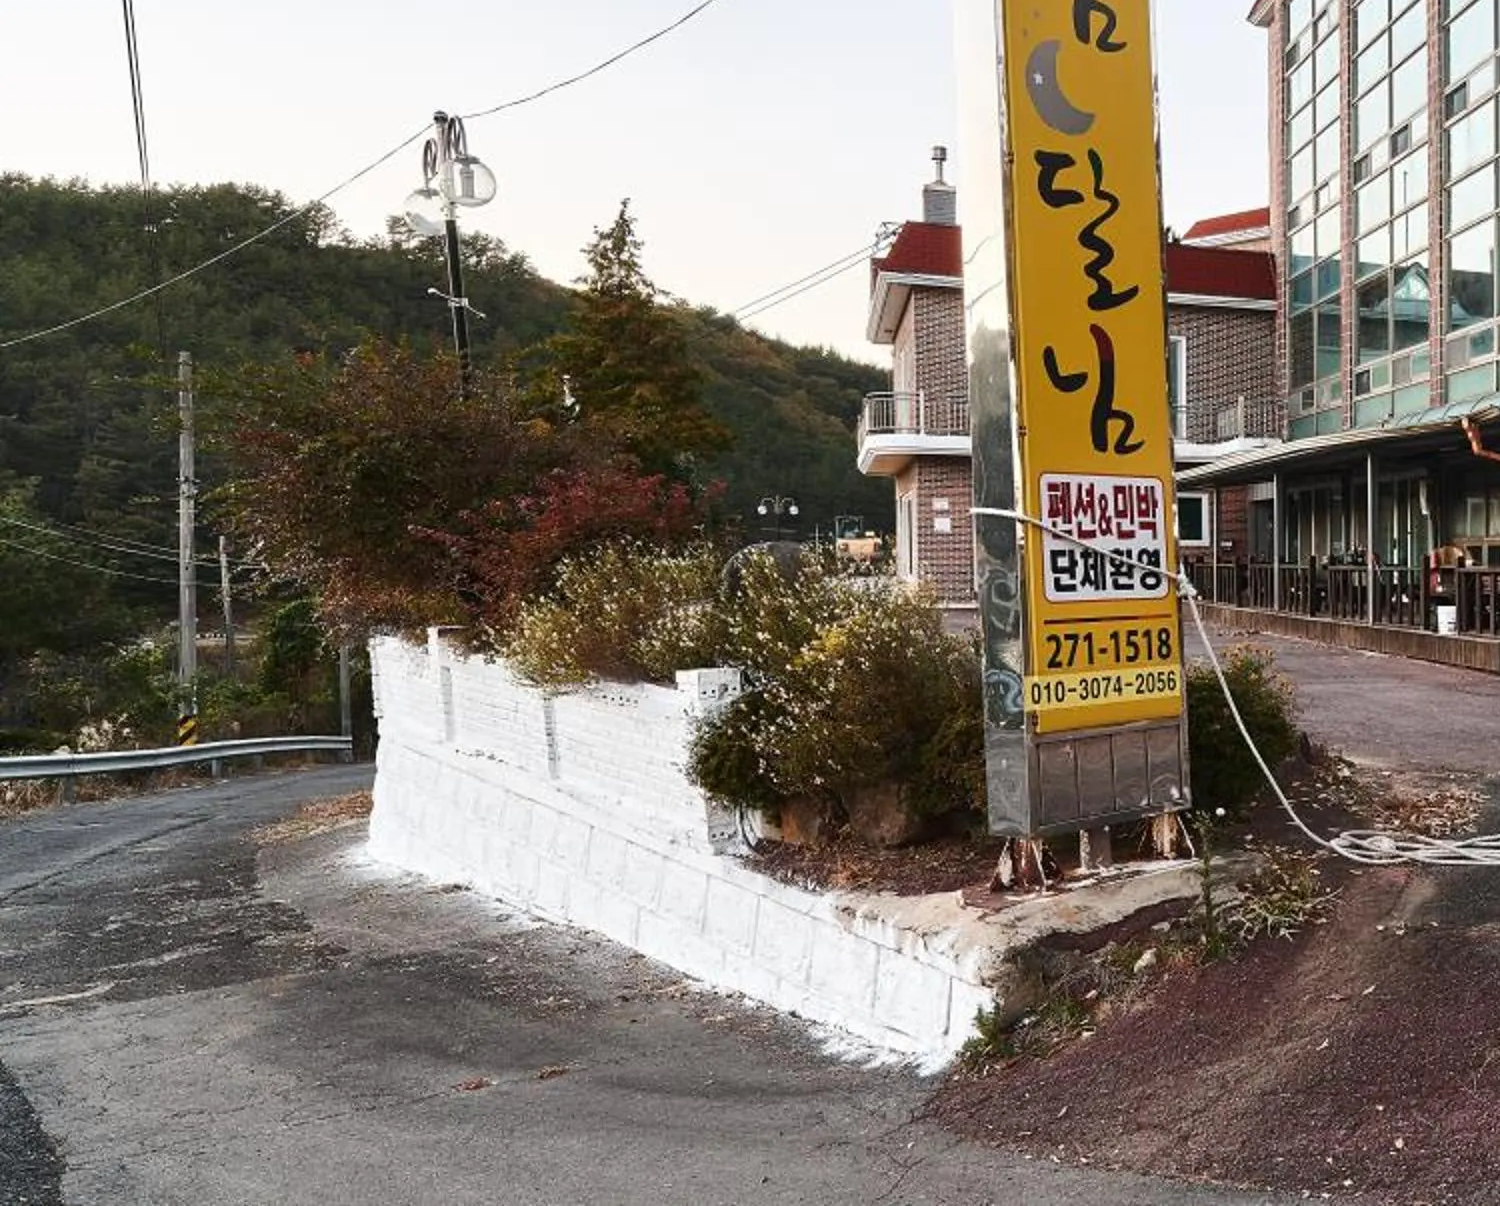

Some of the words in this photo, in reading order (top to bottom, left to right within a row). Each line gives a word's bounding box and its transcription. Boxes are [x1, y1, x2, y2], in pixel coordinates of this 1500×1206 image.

[1034, 148, 1145, 455] 달님
[1047, 481, 1159, 541] 펜션&민박
[1049, 547, 1163, 593] 단체환영
[1045, 627, 1173, 669] 271-1518
[1031, 670, 1177, 705] 010-3074-2056
